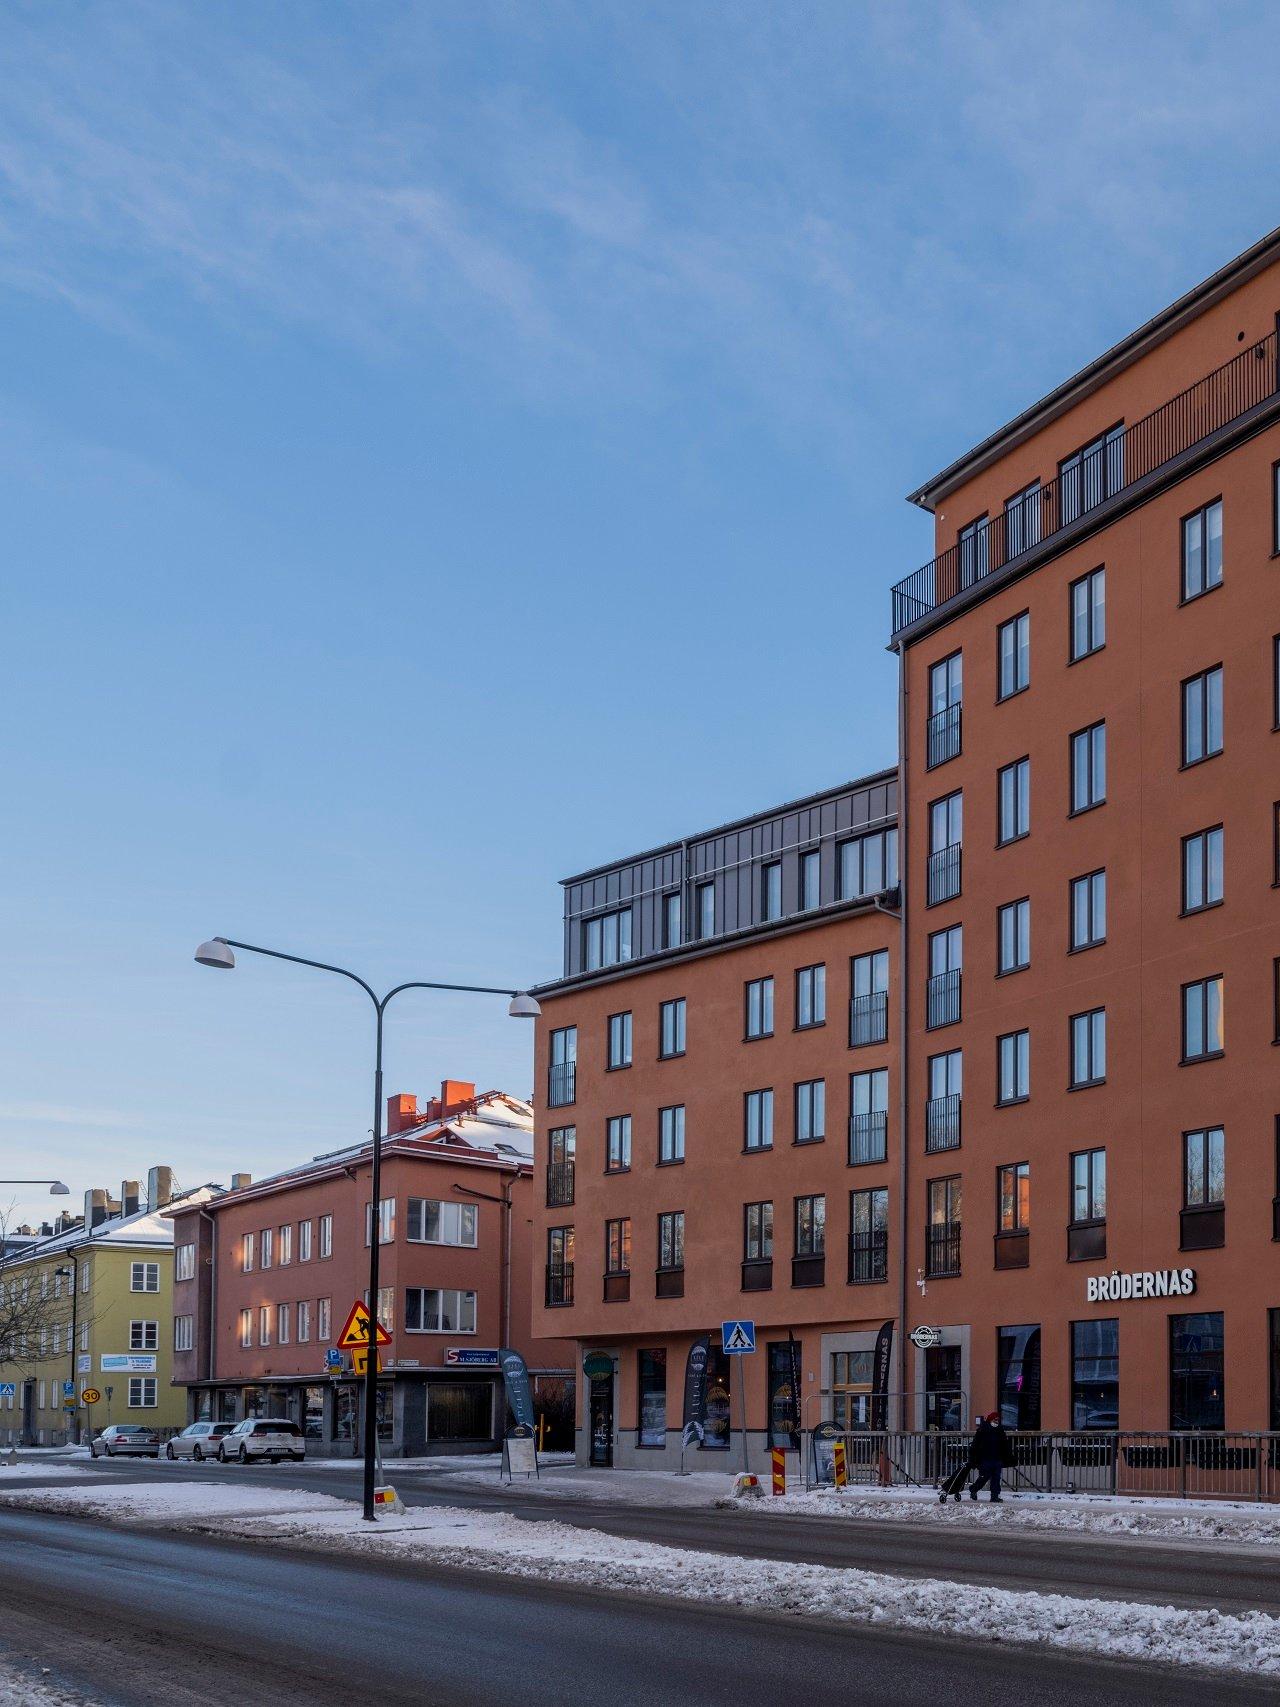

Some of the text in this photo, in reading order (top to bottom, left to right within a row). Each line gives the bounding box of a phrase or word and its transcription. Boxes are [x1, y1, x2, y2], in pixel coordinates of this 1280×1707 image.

[1087, 1268, 1194, 1302] BRÖDERNAS
[330, 1350, 338, 1360] P
[84, 1392, 98, 1401] 30
